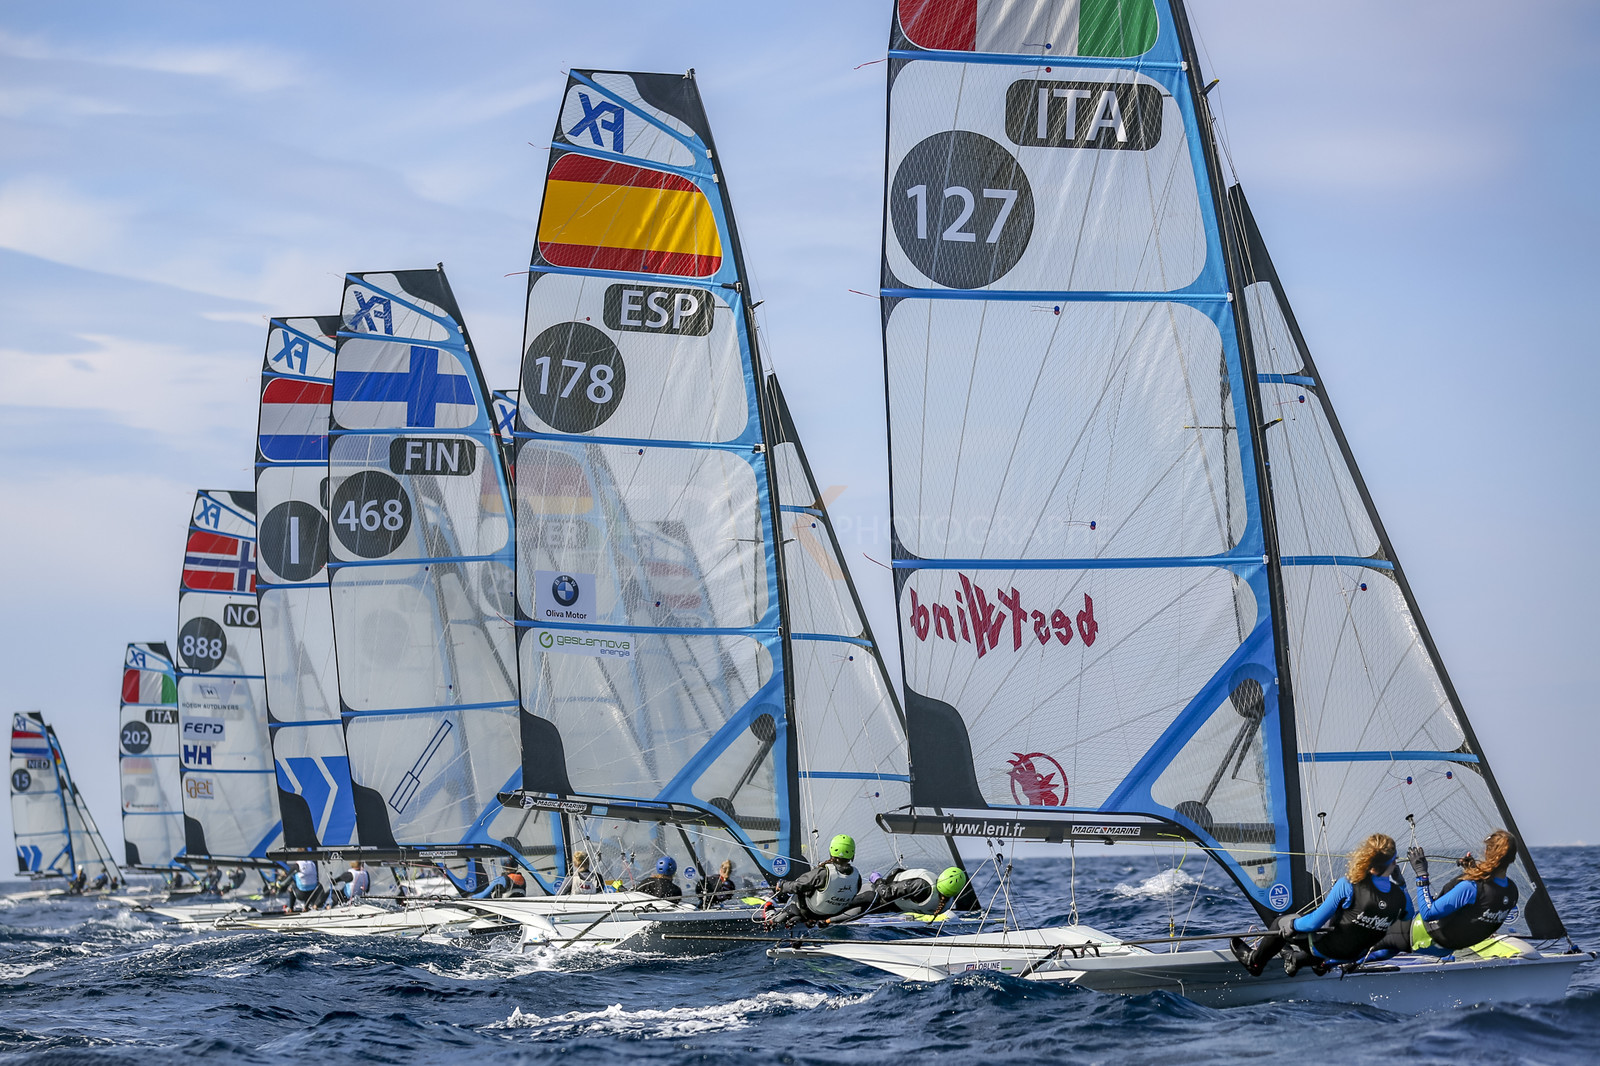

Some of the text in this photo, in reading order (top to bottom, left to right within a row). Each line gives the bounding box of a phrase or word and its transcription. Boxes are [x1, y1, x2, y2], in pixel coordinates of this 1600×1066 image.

[1036, 87, 1128, 143] ITA
[906, 183, 1018, 244] 127
[620, 288, 699, 330] ESP
[535, 355, 614, 405] 178
[404, 441, 460, 473] FIN
[337, 499, 404, 533] 468
[554, 576, 577, 587] BMW
[226, 605, 260, 626] NO
[546, 609, 587, 620] Oliva Motor
[183, 635, 222, 660] 888
[556, 635, 630, 650] gesternova
[151, 711, 172, 723] ITA
[123, 731, 149, 745] 202
[28, 760, 49, 769] NED
[183, 744, 212, 765] HH
[14, 774, 29, 788] 15
[943, 821, 1140, 837] www.leni.fr MAGIC MARINE
